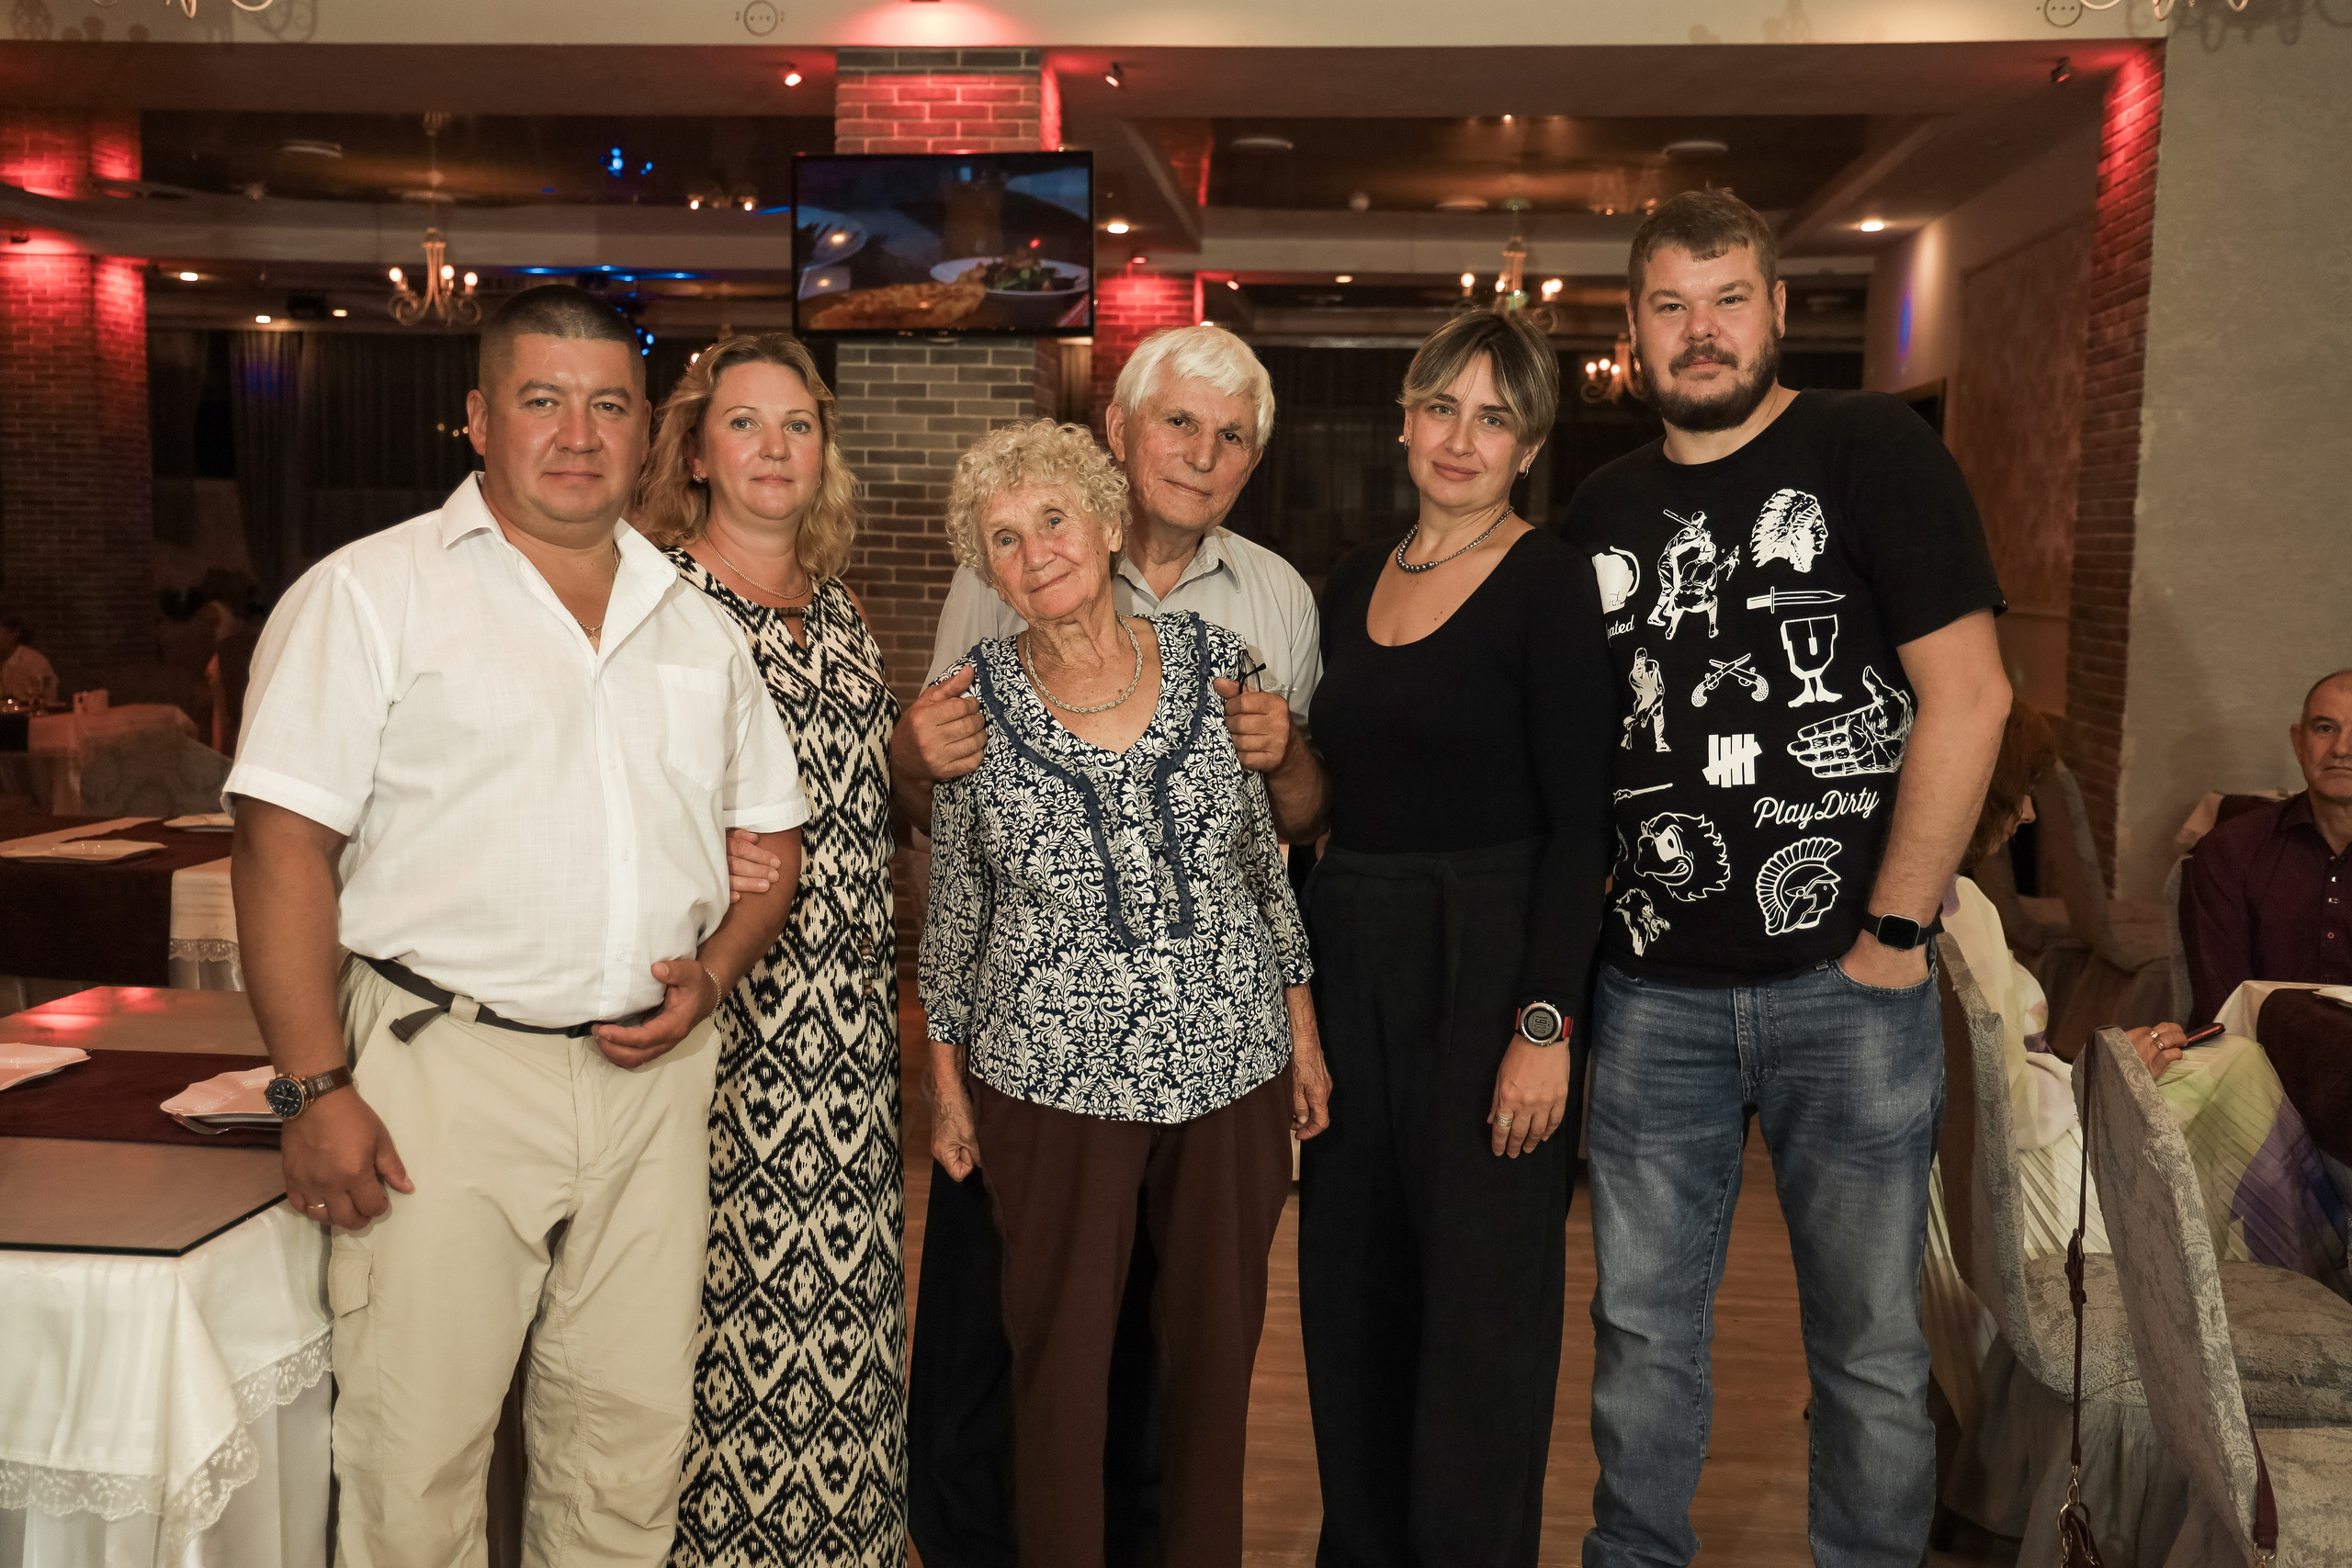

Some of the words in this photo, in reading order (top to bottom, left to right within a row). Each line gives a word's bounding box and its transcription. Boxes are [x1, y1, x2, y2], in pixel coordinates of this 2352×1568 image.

[1606, 614, 1635, 641] ated
[1753, 796, 1814, 829] Play
[1814, 786, 1880, 819] Dirty
